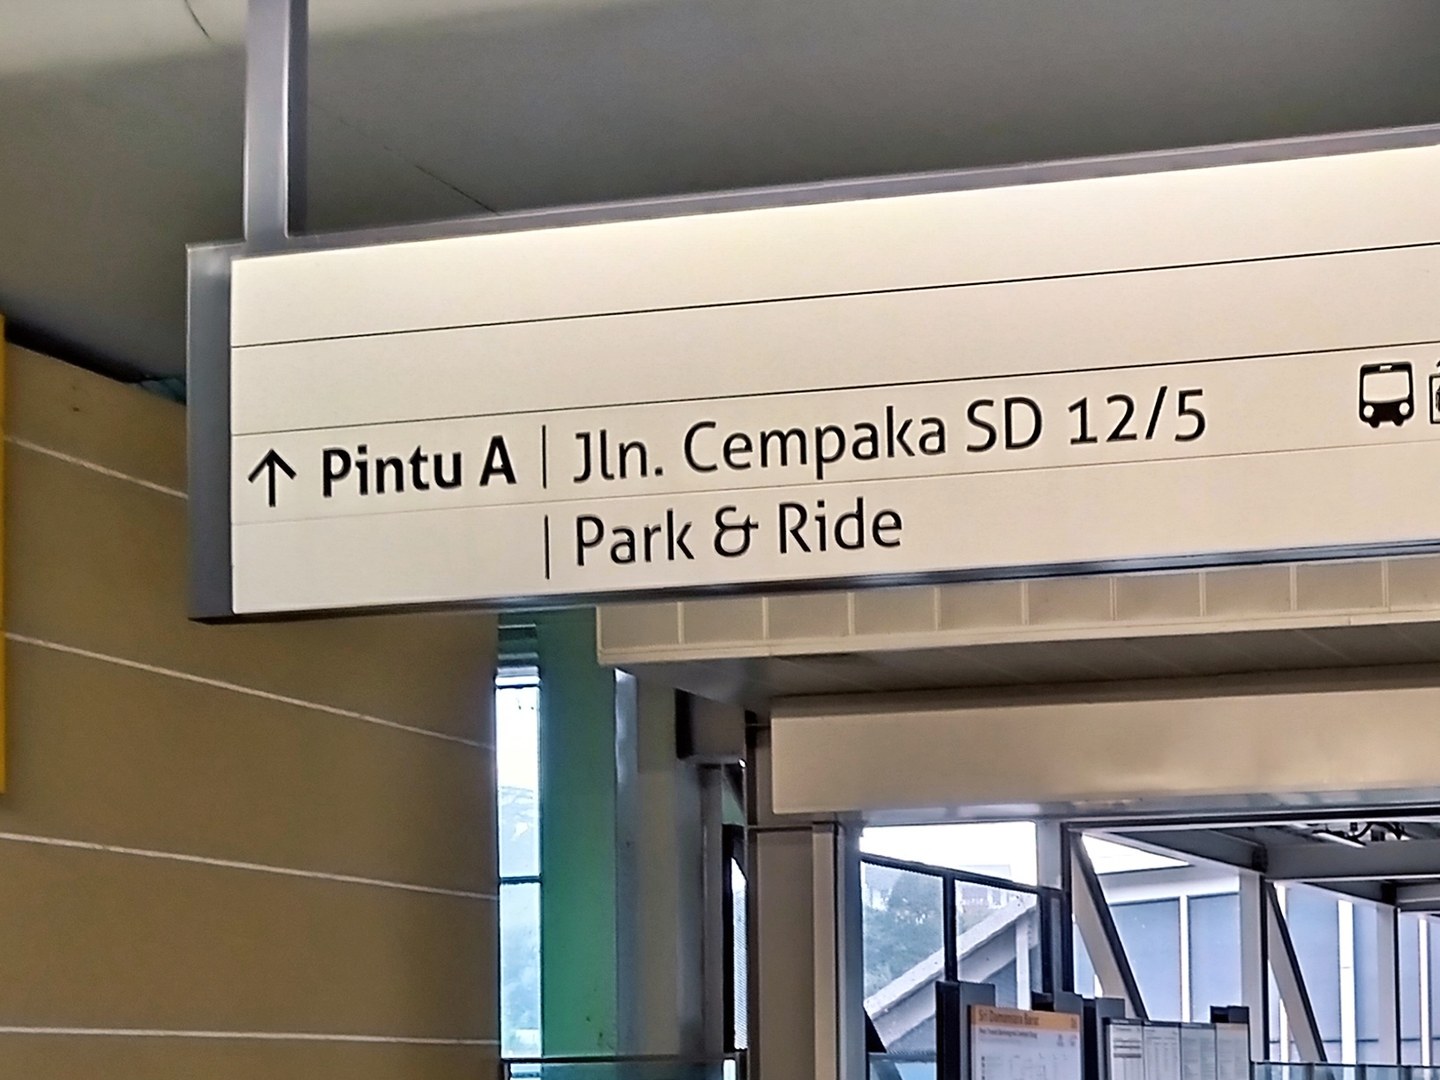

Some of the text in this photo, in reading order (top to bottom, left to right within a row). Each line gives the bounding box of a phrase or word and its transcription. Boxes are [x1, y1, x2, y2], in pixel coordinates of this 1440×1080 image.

[321, 435, 518, 499] Pintu A
[572, 385, 1207, 485] Jln. Cempaka SD 12/5
[575, 495, 904, 568] Park & Ride
